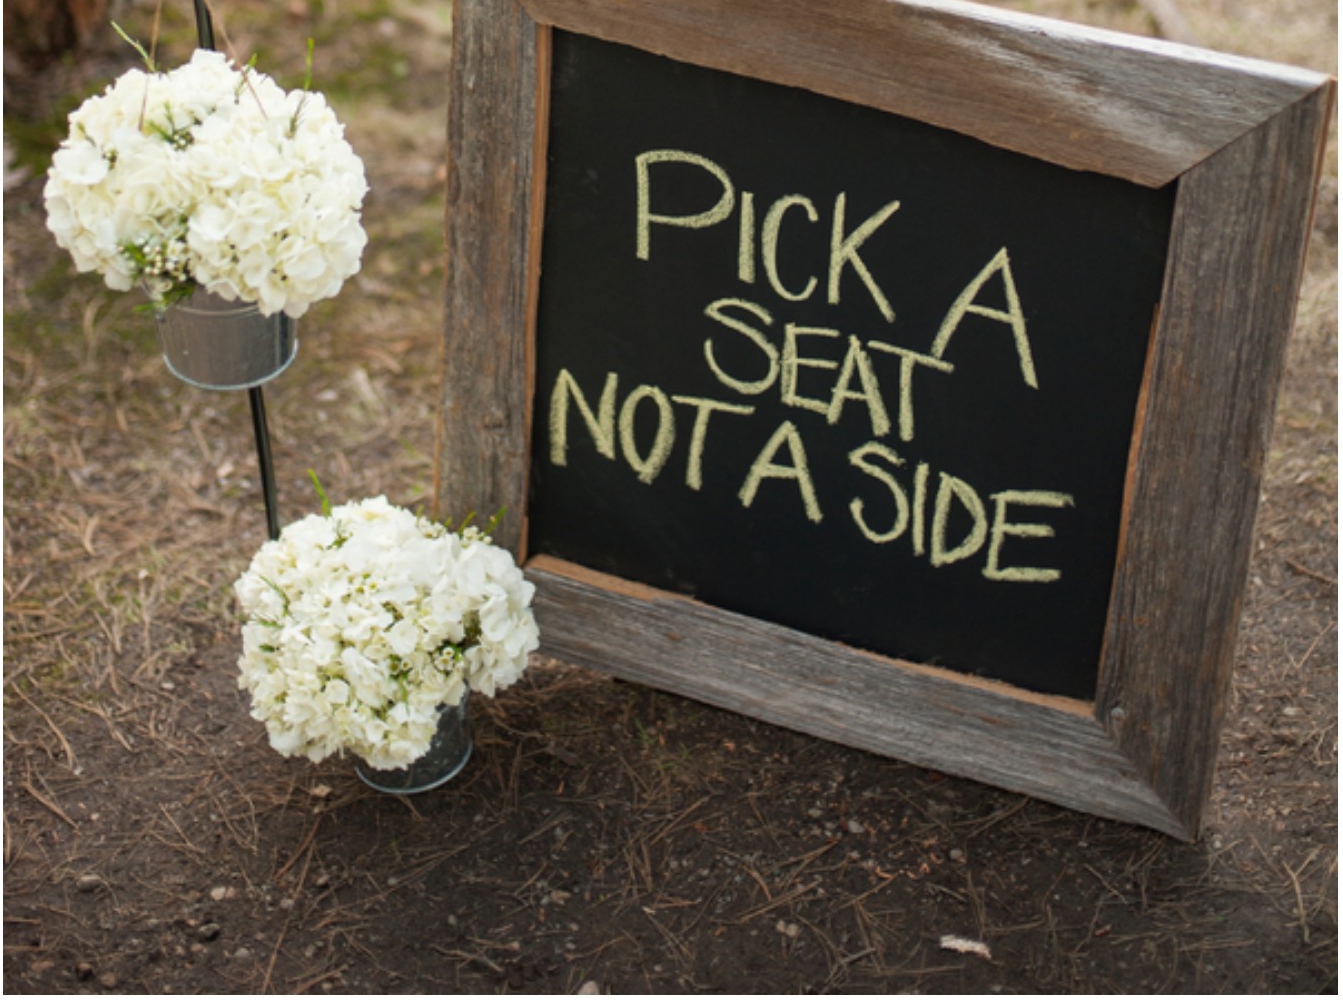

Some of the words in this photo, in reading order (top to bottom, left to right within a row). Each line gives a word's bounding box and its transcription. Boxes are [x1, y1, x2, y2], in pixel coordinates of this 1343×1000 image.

[635, 149, 901, 323] PICK
[930, 246, 1038, 390] A
[703, 297, 954, 441] SEAT
[549, 368, 756, 491] NOT
[737, 420, 823, 524] A
[848, 440, 1074, 582] SIDE
